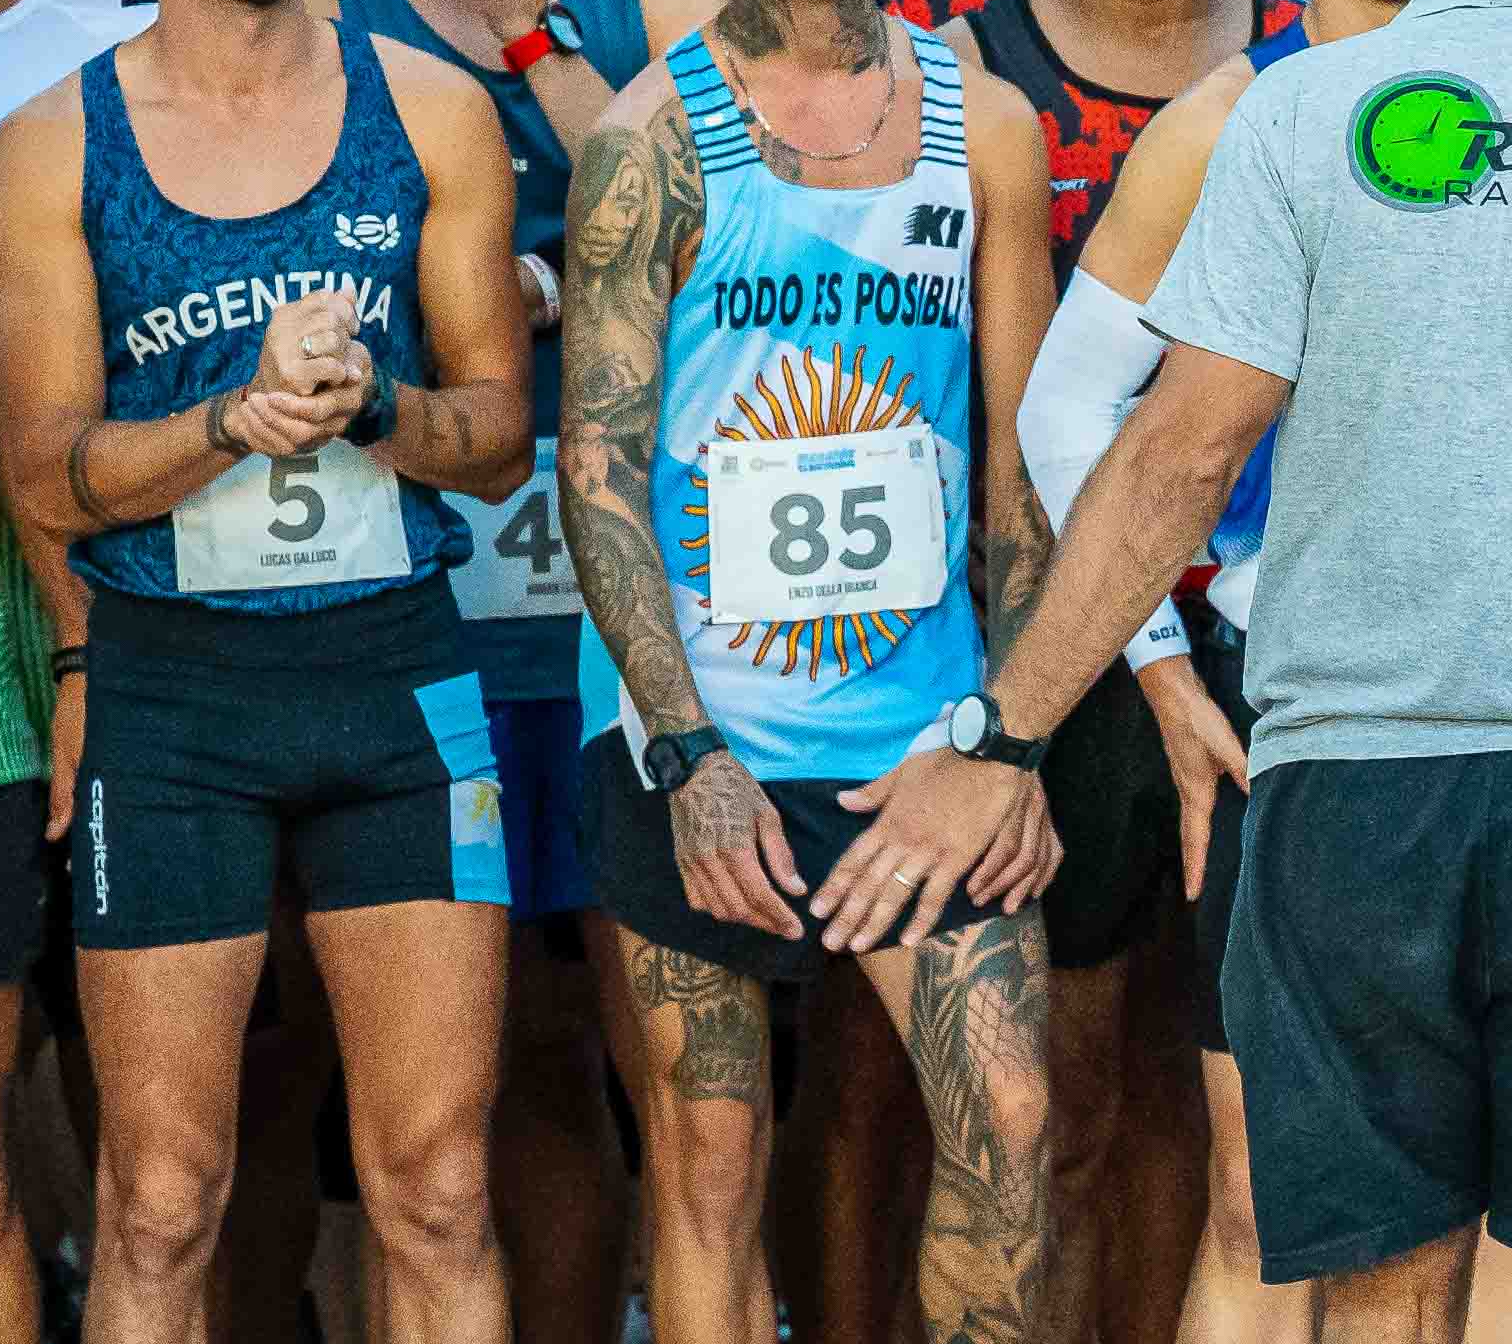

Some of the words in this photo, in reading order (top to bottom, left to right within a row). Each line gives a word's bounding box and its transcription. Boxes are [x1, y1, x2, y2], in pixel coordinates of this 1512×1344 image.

[713, 272, 804, 331] TODO
[811, 271, 843, 328] ES
[267, 455, 326, 544] 5
[769, 485, 892, 576] 85
